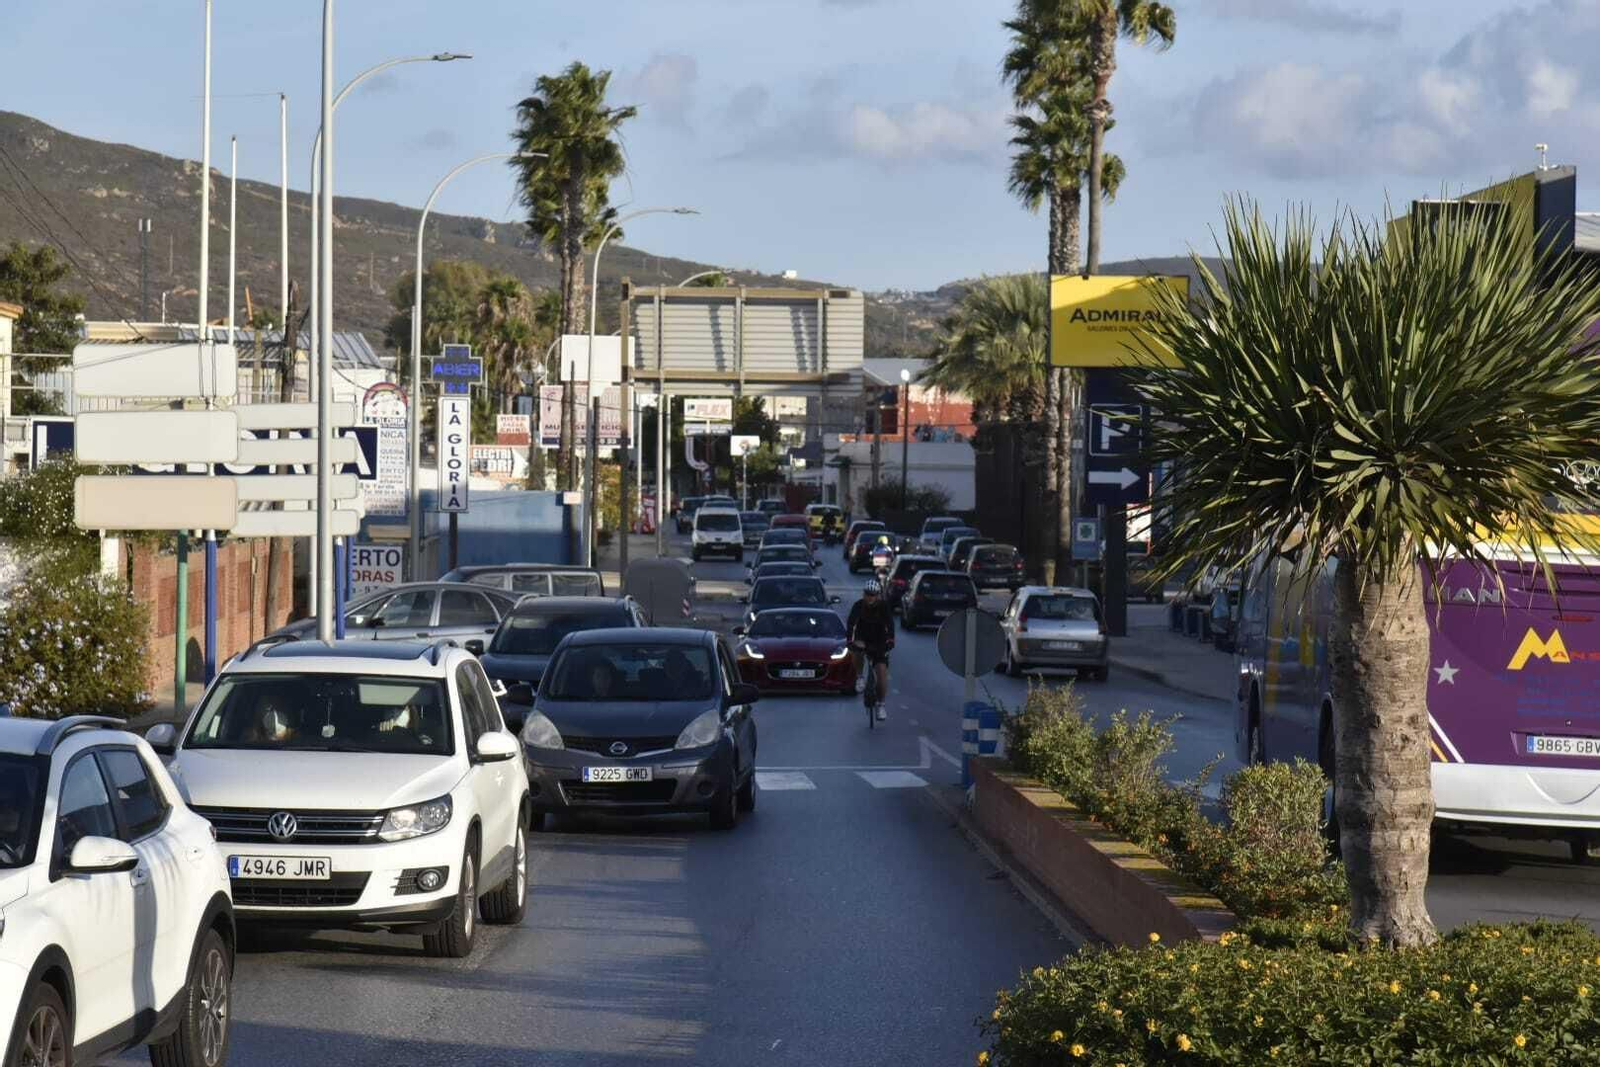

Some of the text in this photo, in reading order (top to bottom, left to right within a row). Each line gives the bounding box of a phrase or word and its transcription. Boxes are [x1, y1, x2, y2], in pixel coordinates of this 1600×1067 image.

[447, 402, 462, 508] LA GLORIA
[1536, 739, 1572, 752] 9865
[592, 768, 621, 780] 9225
[243, 859, 325, 877] 4946 JMR
